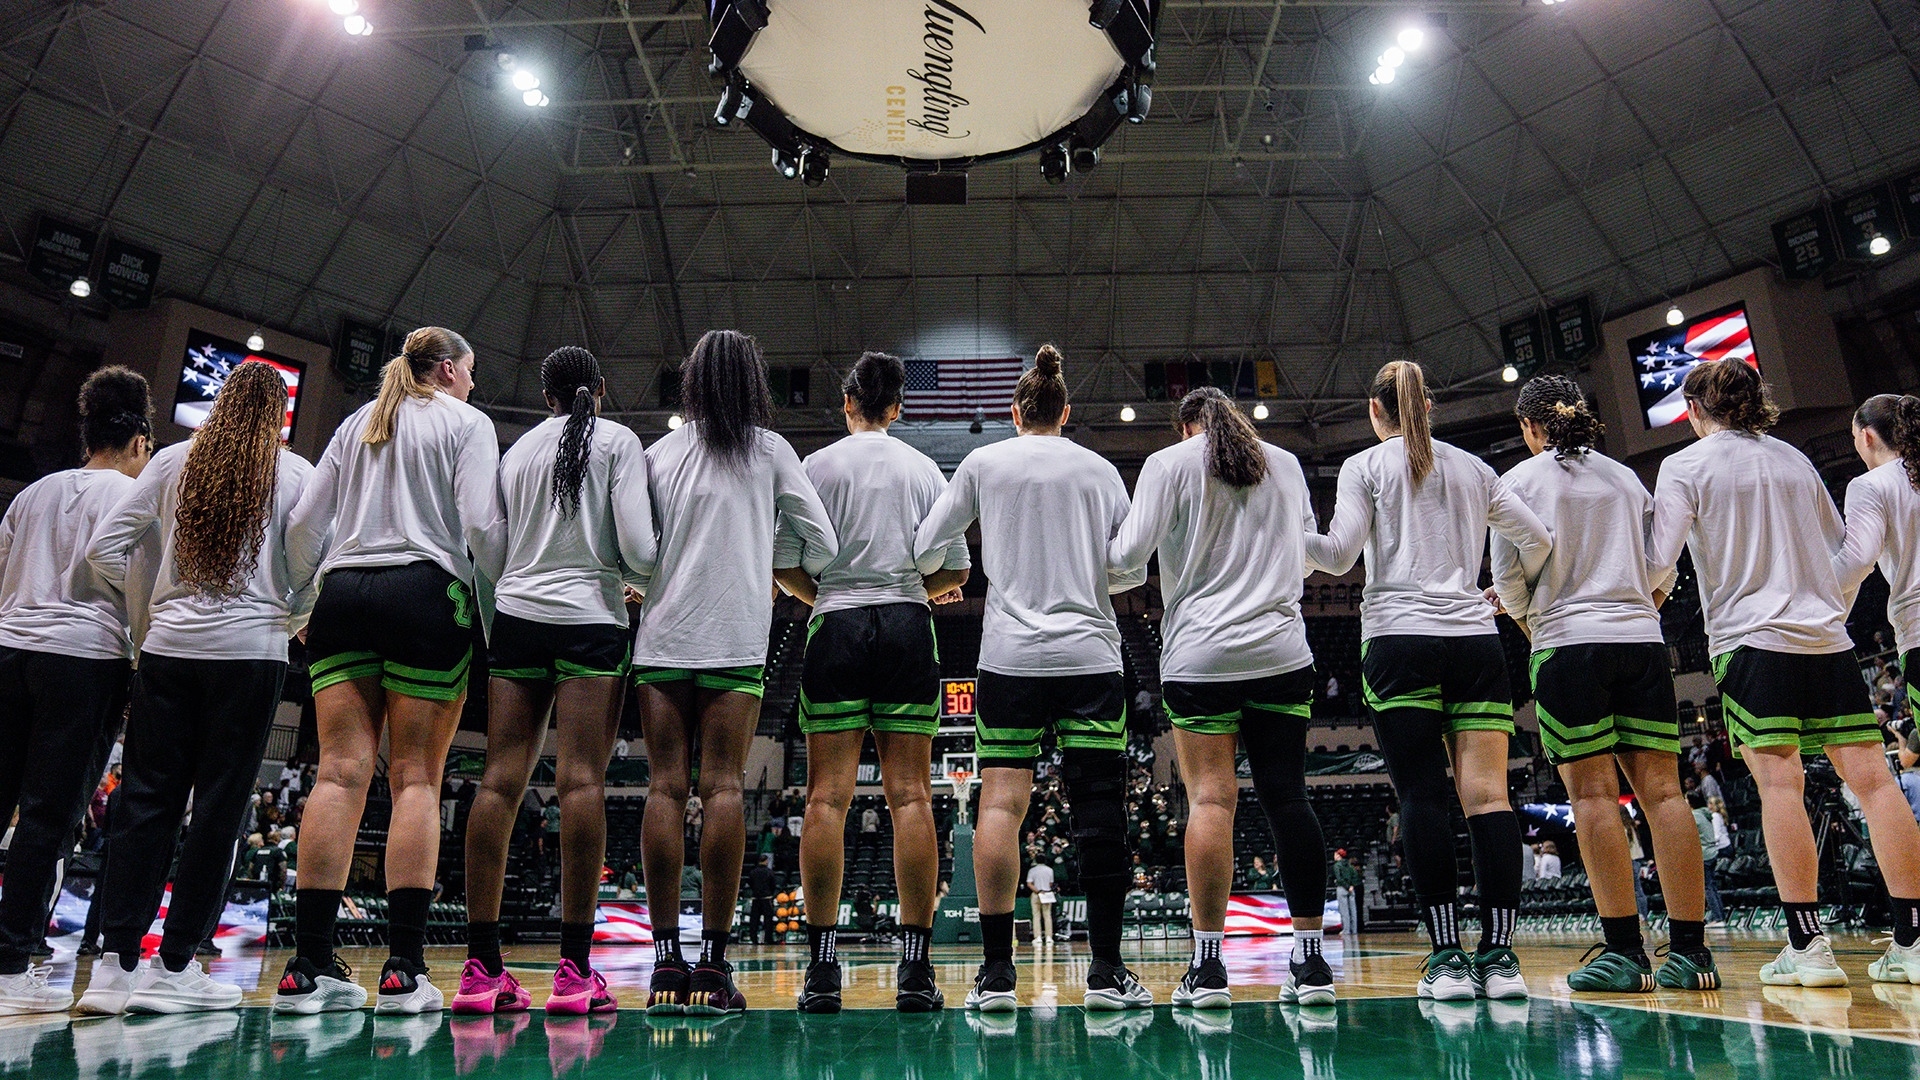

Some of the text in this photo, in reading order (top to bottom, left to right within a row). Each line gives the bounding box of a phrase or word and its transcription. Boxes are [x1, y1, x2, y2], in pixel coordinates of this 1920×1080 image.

[886, 85, 906, 142] CENTER
[52, 231, 81, 249] AMIR
[1794, 240, 1820, 263] 25
[119, 253, 144, 271] DICK
[108, 262, 150, 285] BOWERS
[1562, 326, 1583, 346] 50
[351, 349, 370, 368] 30
[1515, 344, 1534, 362] 33
[946, 682, 974, 694] 10:47
[946, 694, 972, 714] 30
[943, 909, 963, 918] TGH
